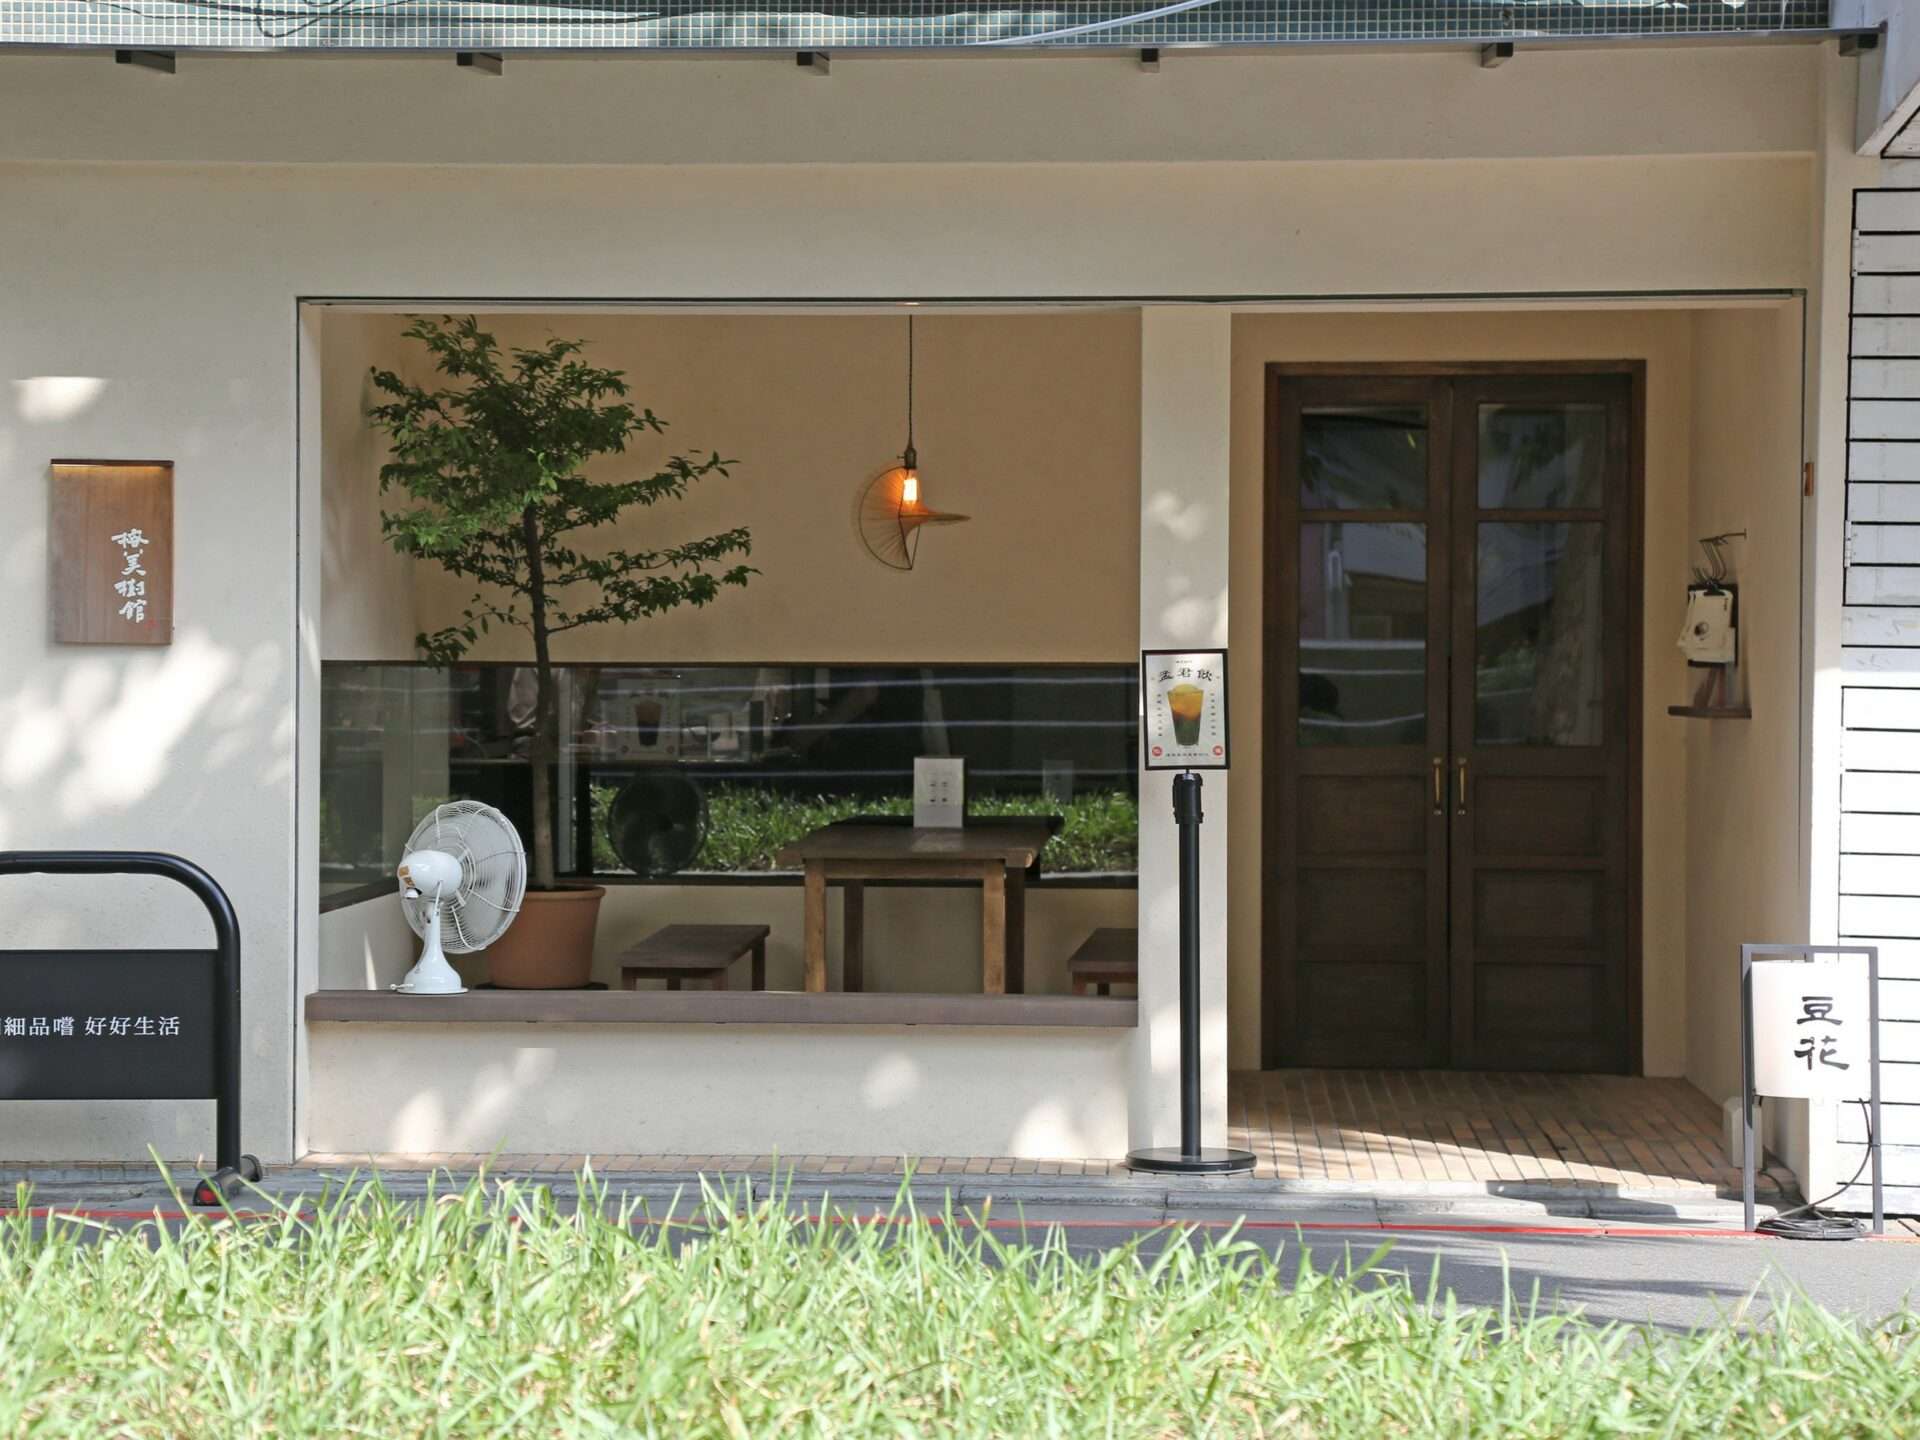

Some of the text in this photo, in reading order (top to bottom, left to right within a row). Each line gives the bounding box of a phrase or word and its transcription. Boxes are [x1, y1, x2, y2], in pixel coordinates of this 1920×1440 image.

[0, 1016, 181, 1037] 細品嚐 好好生活
[1793, 996, 1850, 1071] 豆花
